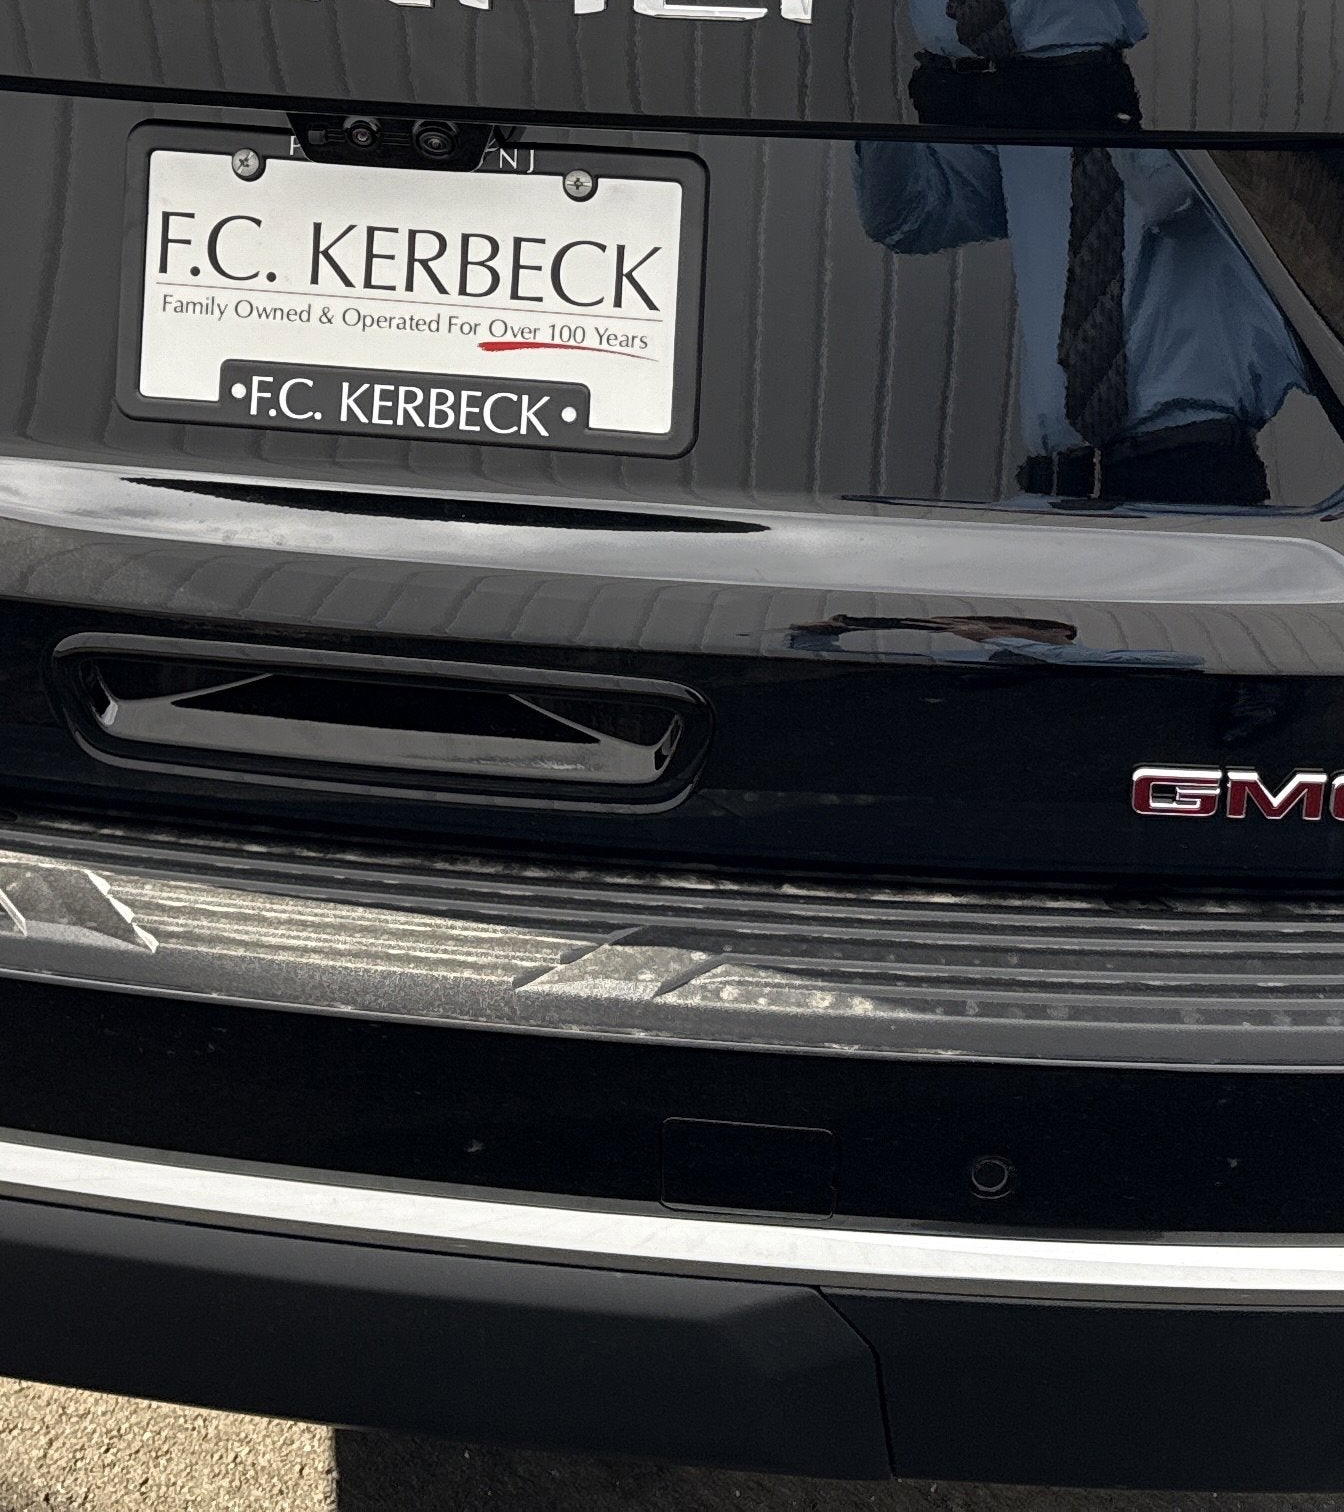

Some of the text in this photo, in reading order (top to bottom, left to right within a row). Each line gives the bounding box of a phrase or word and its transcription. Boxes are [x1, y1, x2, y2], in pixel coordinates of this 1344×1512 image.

[158, 210, 663, 312] F.C. KERBECK
[162, 294, 649, 350] Family Owned & Operated For Over 100 Years
[249, 375, 551, 437] F.C. KERBECK
